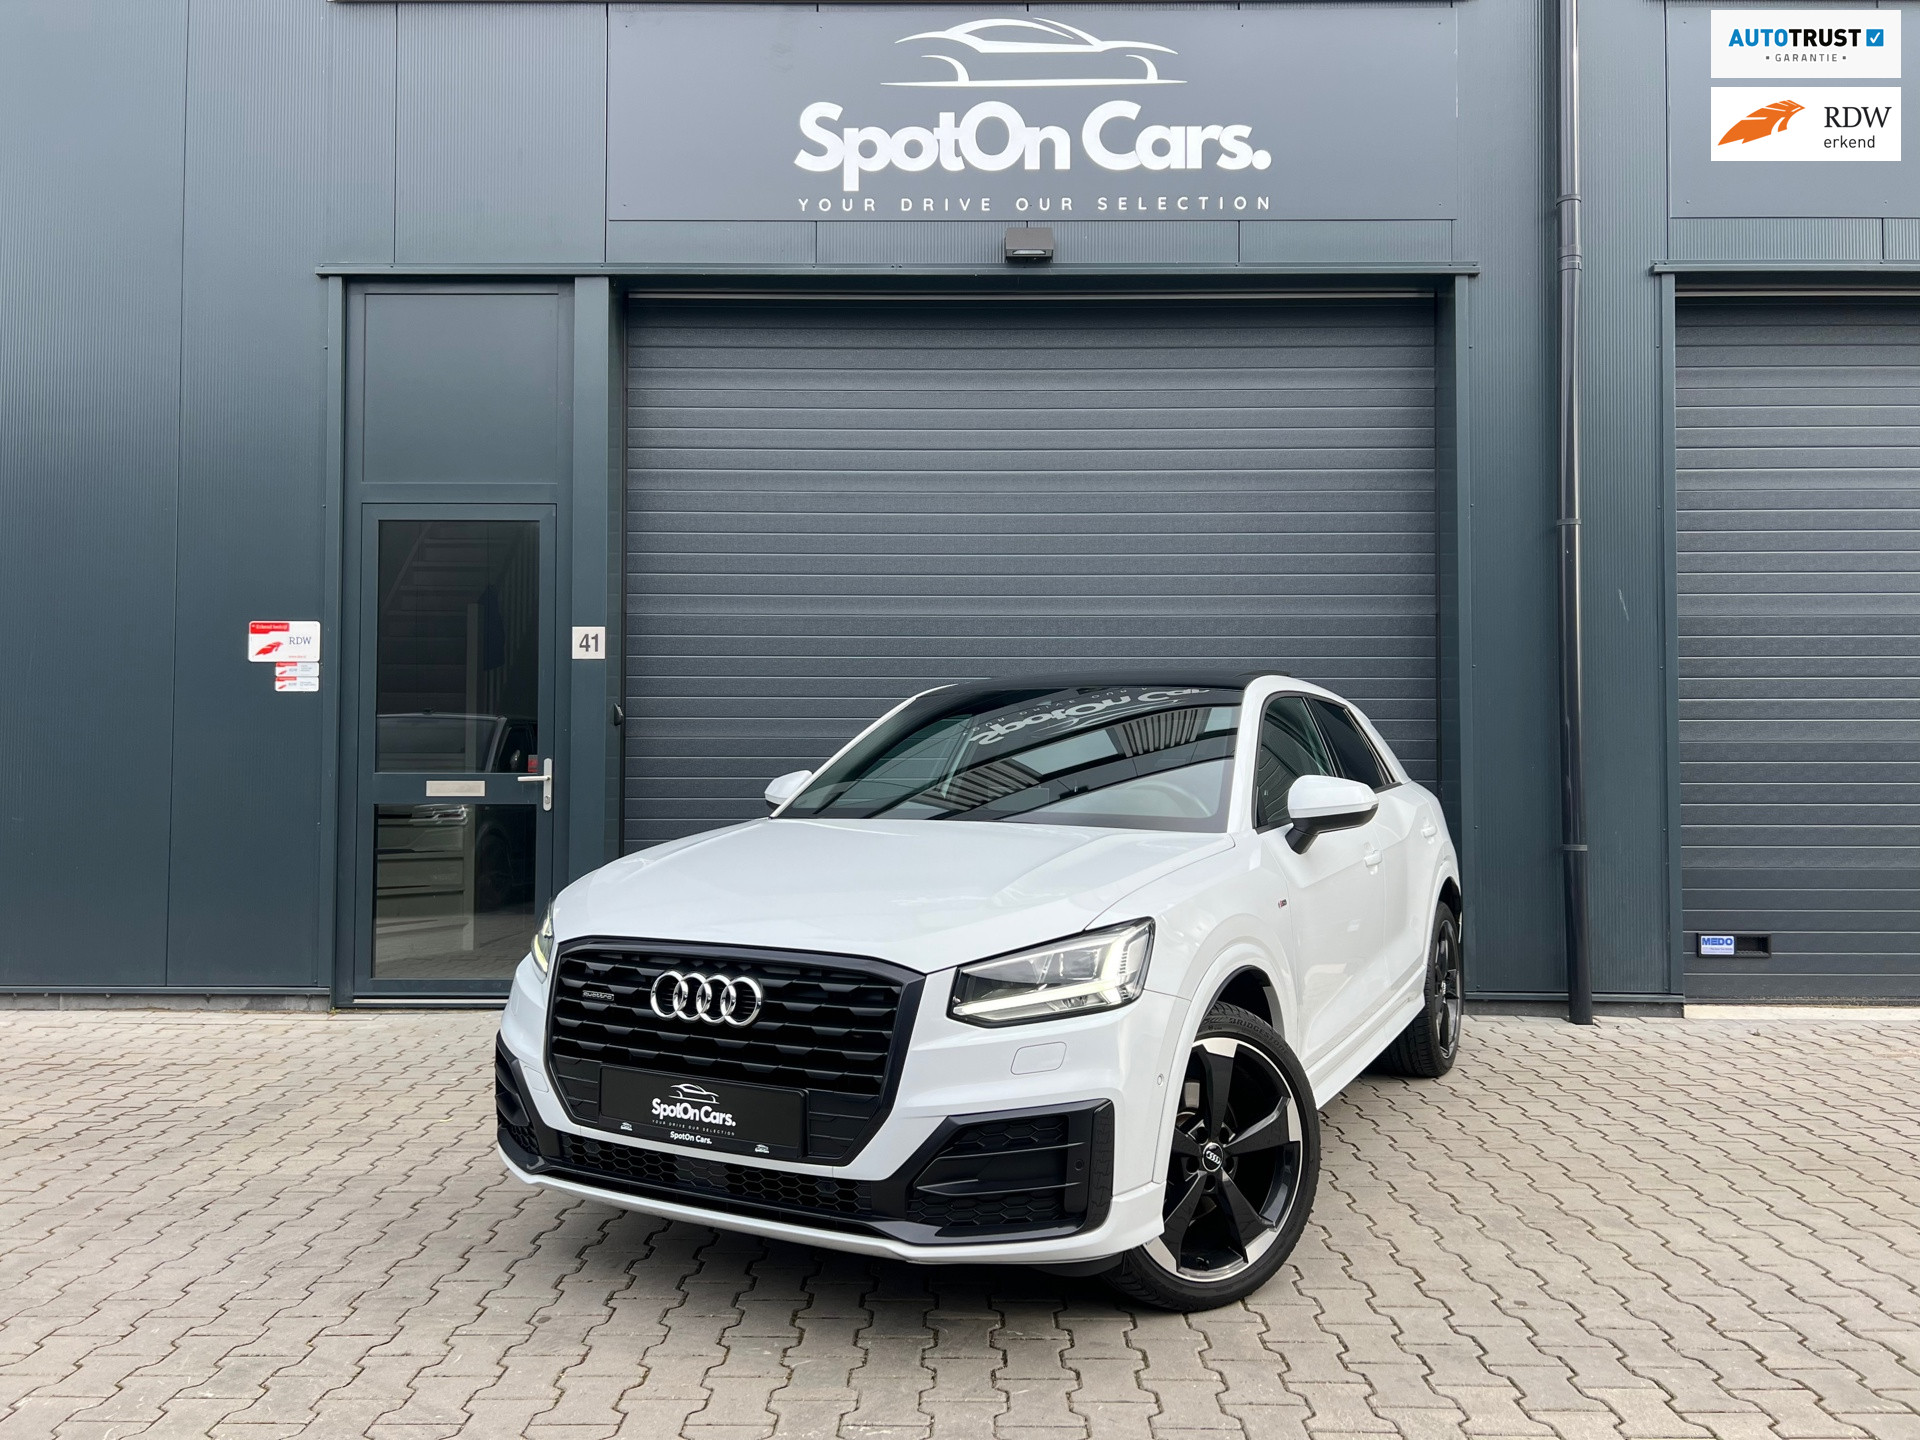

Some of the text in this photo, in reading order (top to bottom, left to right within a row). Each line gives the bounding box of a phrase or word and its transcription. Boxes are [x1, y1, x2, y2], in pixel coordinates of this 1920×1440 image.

[794, 100, 1272, 192] SpotOn Cars.
[798, 196, 1271, 213] YOUR DRIVE OUR SELECTION
[289, 637, 311, 645] RDW
[578, 633, 599, 652] 41
[1702, 938, 1733, 946] MEDO
[651, 1098, 737, 1127] SpotOn Cars.
[670, 1130, 712, 1145] SpotOn Cars.
